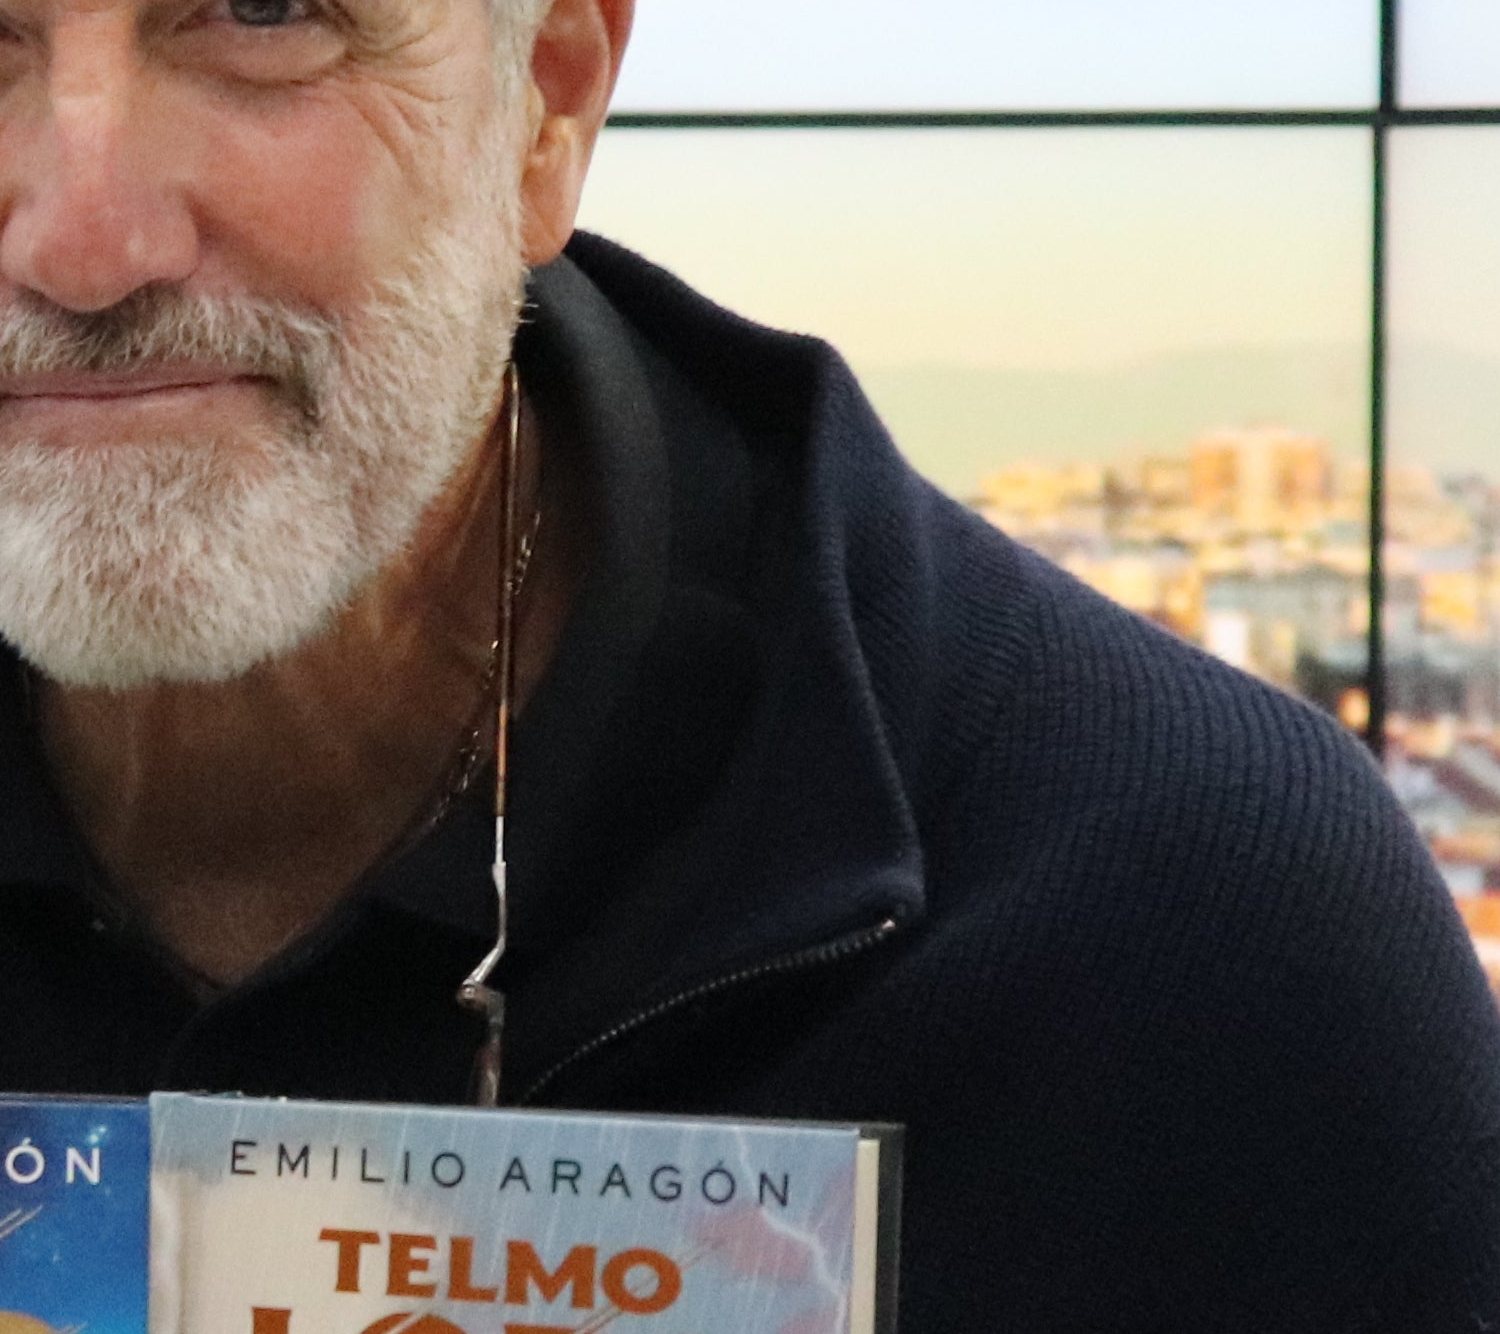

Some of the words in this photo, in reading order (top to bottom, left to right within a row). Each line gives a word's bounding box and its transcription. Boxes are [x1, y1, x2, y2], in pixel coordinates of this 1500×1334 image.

[230, 1140, 466, 1189] EMILIO
[500, 1158, 790, 1208] ARAGÓN
[319, 1228, 682, 1315] TELMO
